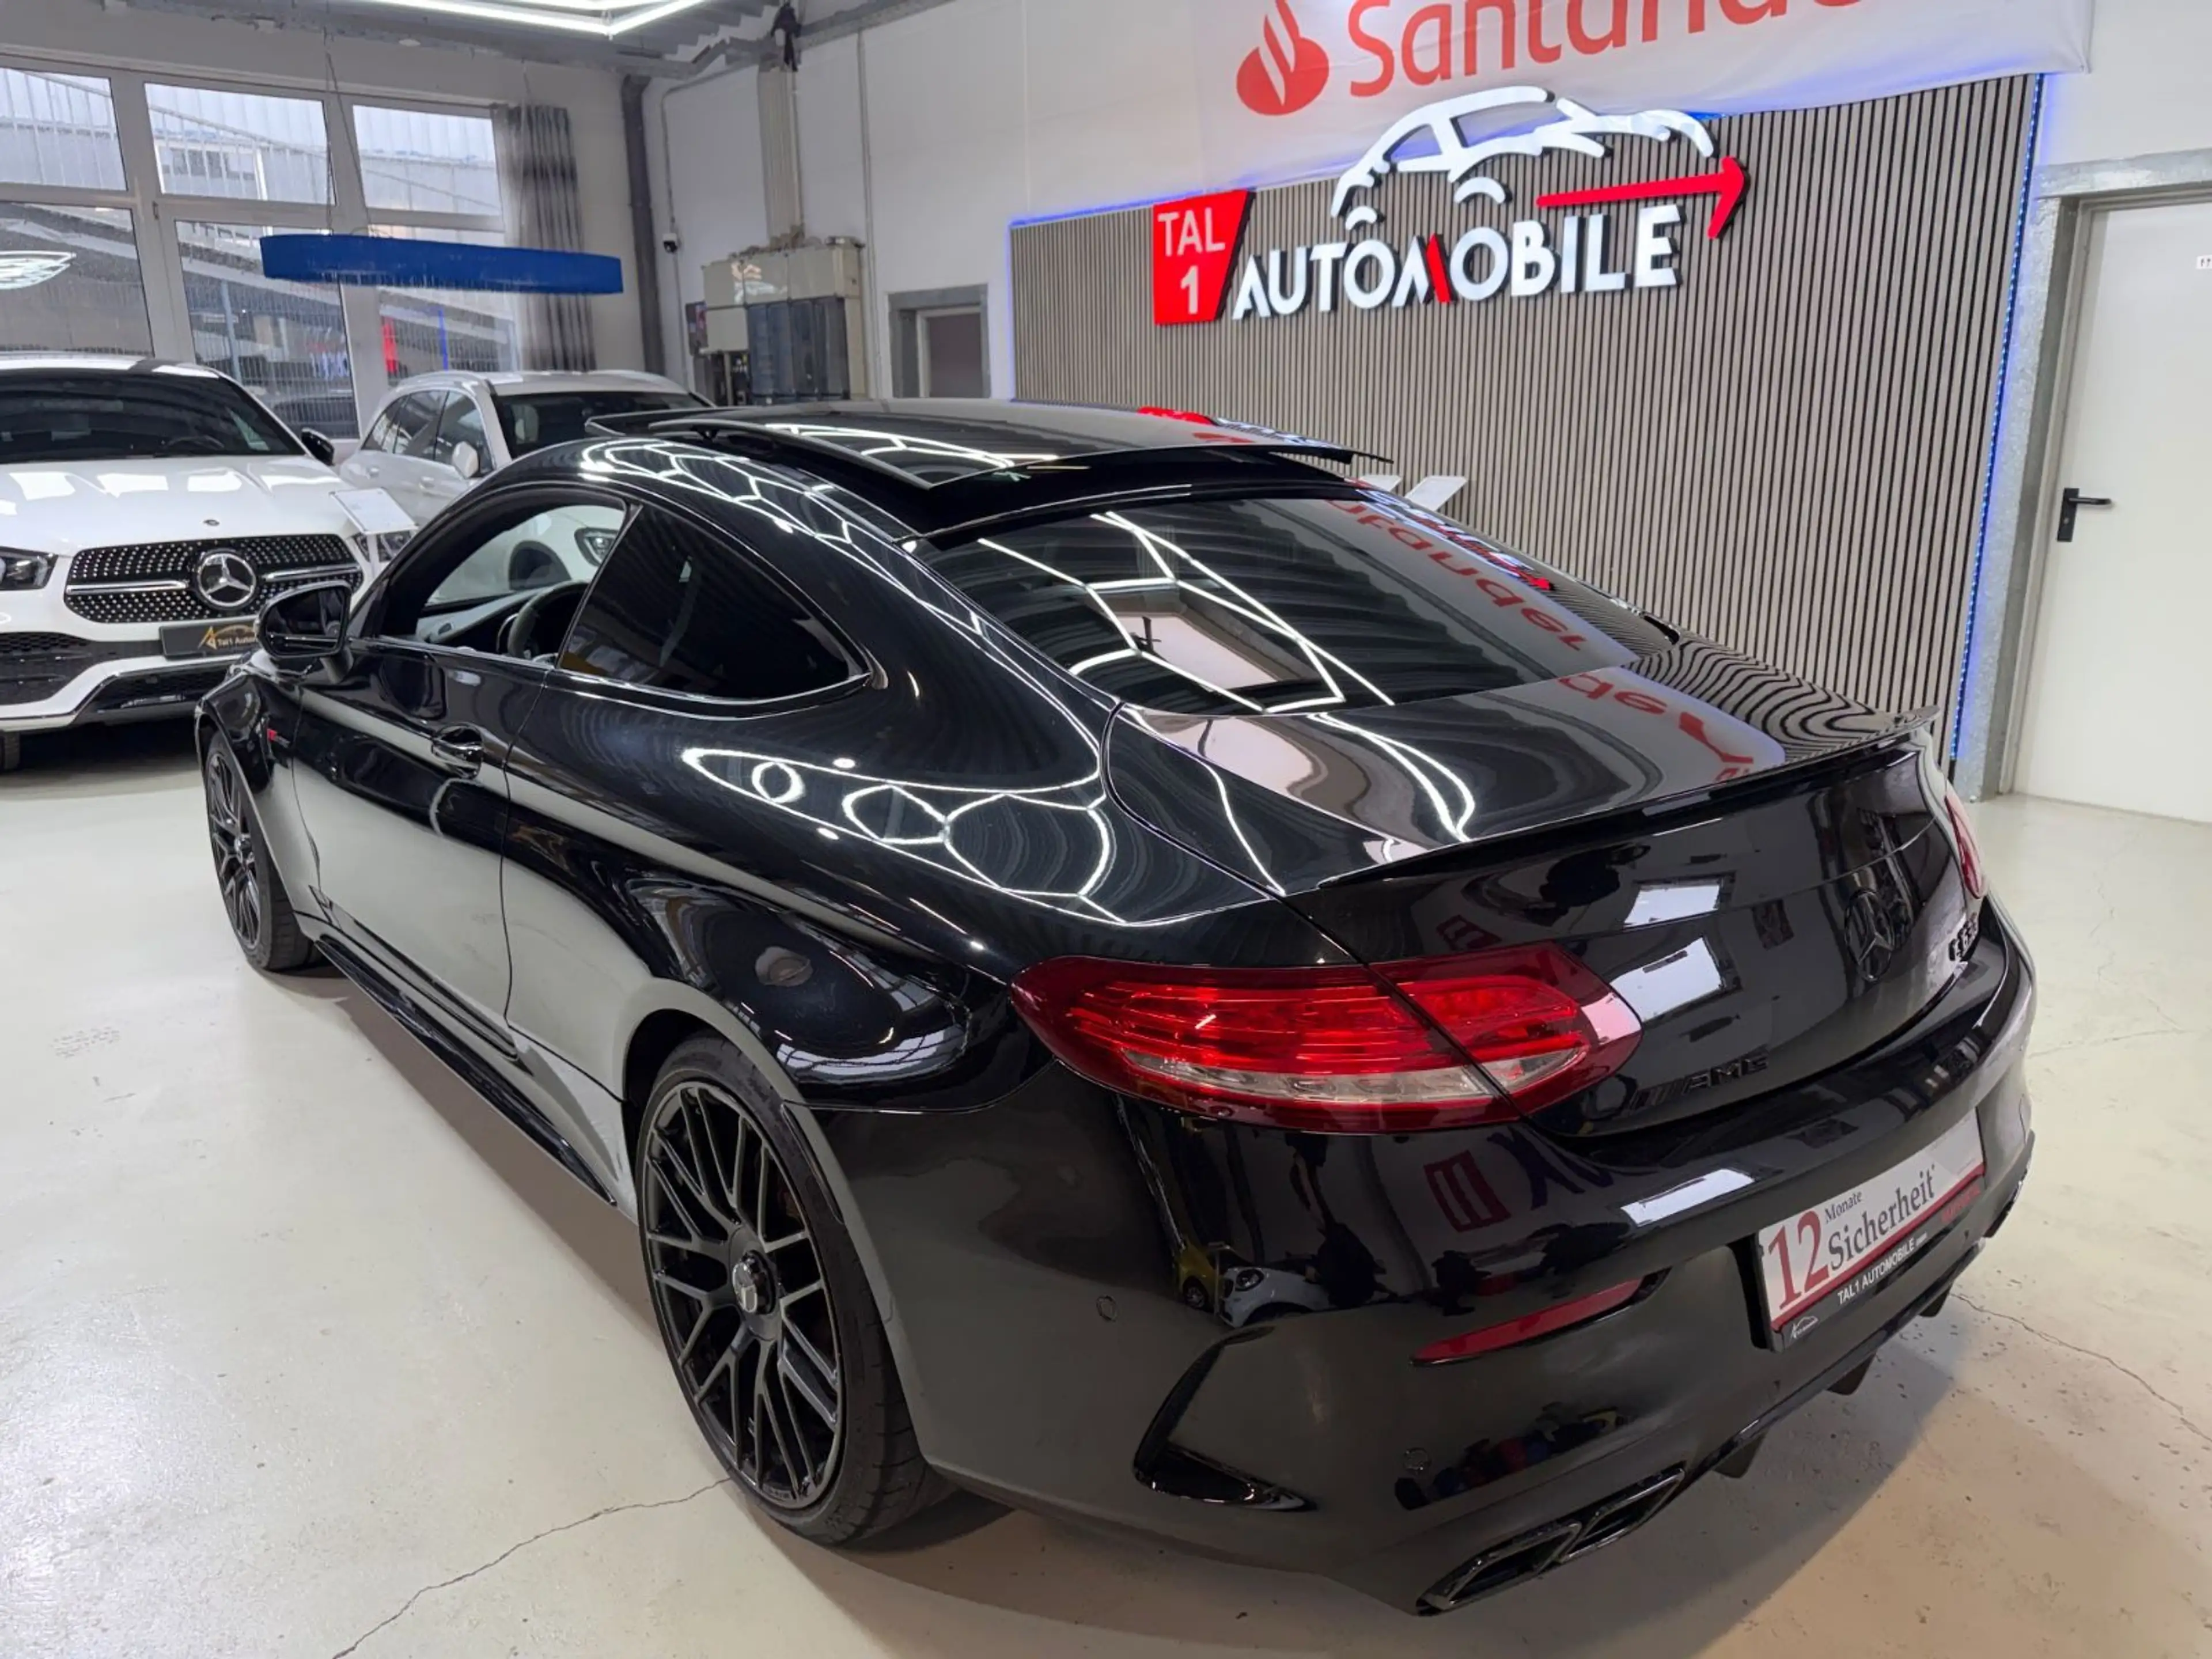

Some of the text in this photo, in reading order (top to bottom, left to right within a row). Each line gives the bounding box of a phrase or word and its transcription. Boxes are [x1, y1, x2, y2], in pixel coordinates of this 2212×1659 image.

[1348, 0, 1862, 97] Santan
[1157, 207, 1225, 256] TAL
[1232, 204, 1681, 321] AUTOMOBILE
[1180, 266, 1199, 315] 1
[1768, 1210, 1830, 1310] 12
[1824, 1191, 1862, 1224] Monate
[1862, 1238, 1915, 1290] AUTOMOBILE
